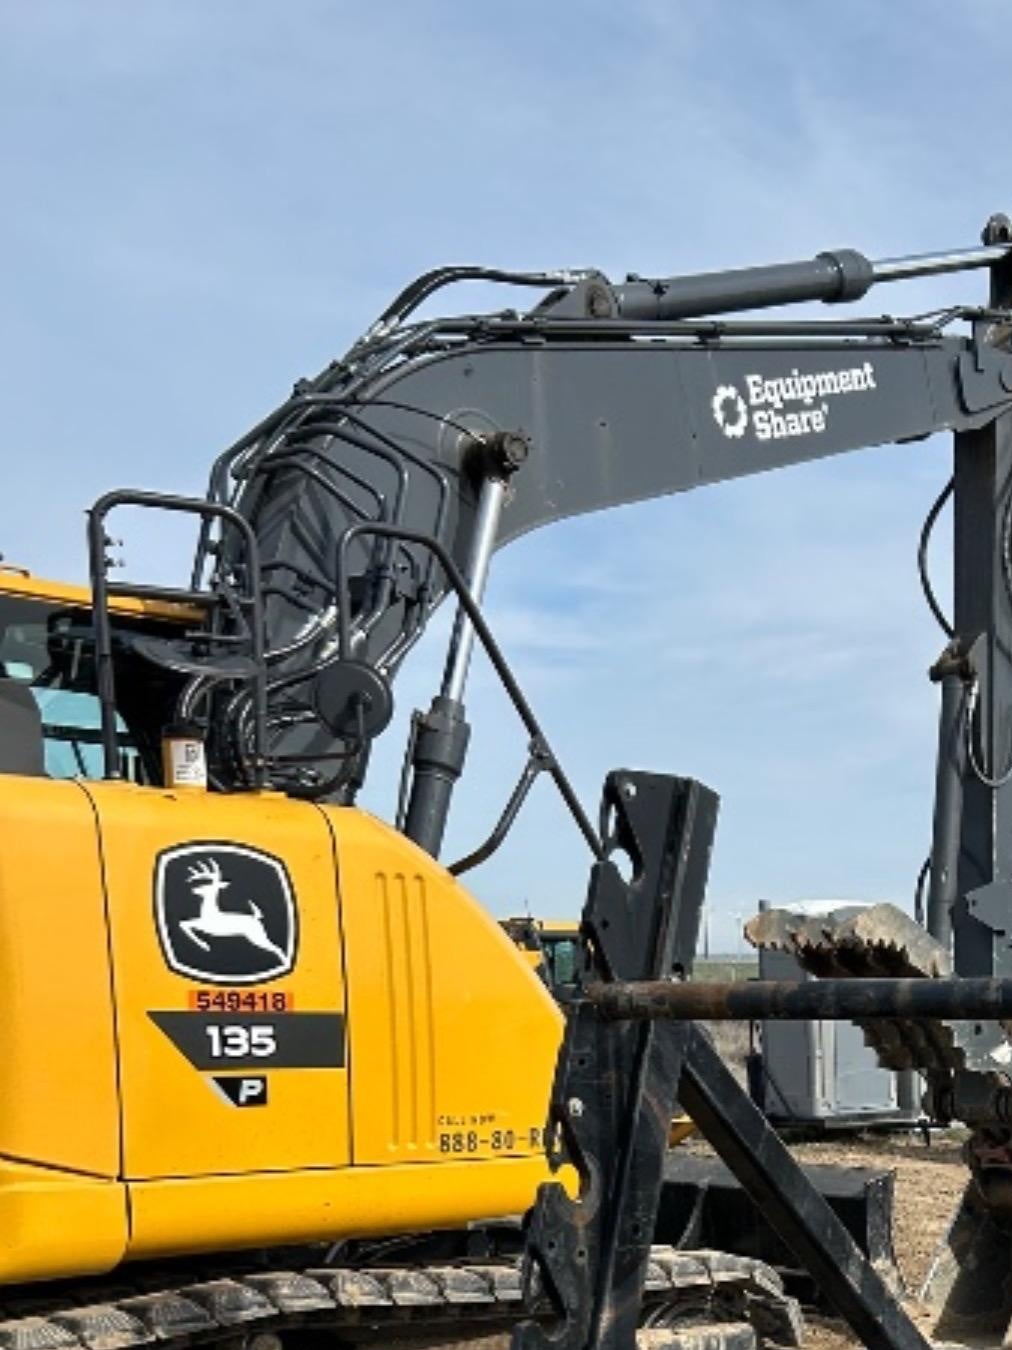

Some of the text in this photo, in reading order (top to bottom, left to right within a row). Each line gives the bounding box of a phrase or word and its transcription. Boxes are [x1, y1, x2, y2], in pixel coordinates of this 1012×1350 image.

[744, 362, 876, 409] Equipment
[752, 406, 827, 441] Share
[196, 990, 286, 1012] 549418
[205, 1024, 277, 1057] 135
[239, 1079, 264, 1104] P
[439, 1127, 549, 1153] 888-80-R
